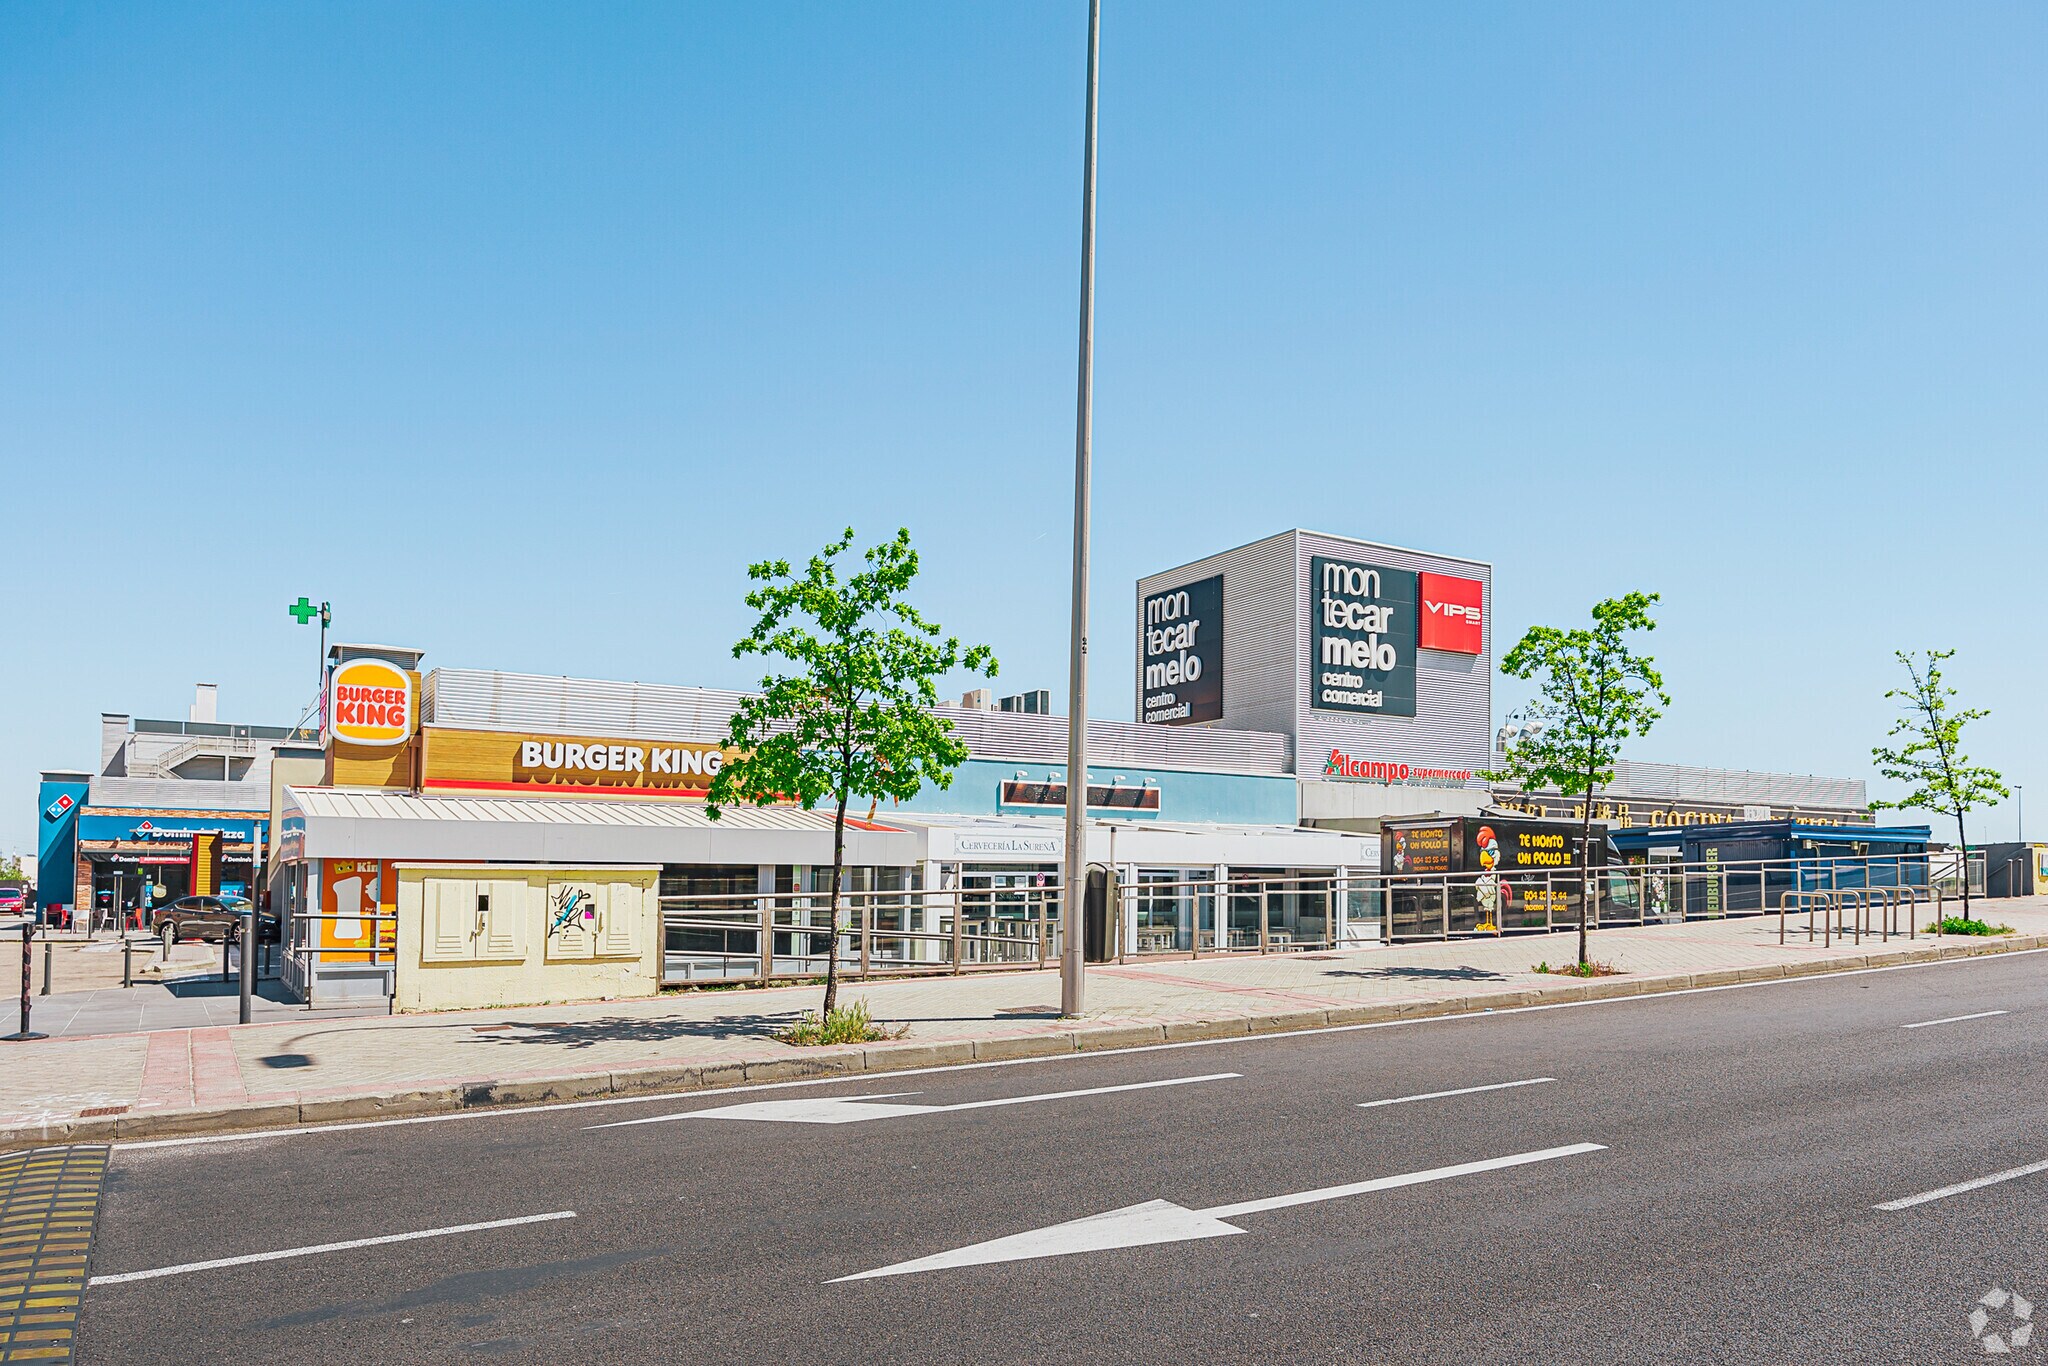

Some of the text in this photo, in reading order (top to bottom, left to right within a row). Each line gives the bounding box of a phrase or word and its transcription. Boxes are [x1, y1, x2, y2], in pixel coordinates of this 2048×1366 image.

[1323, 563, 1380, 599] mon
[1148, 590, 1190, 625] mon
[1321, 591, 1393, 634] tecar
[1424, 600, 1481, 620] VIPS
[1146, 619, 1200, 656] tecar
[1322, 633, 1397, 671] melo
[1146, 649, 1202, 690] melo
[1322, 671, 1364, 688] centro
[337, 685, 406, 705] BURGER
[1145, 691, 1177, 709] centro
[1322, 688, 1383, 708] comercial
[336, 702, 405, 727] KING
[1145, 701, 1191, 723] comercial
[522, 741, 724, 776] BURGER KING
[1325, 748, 1471, 783] Alcampo supermercado
[962, 840, 1056, 852] CERVECERÍA LA SUREÑA
[1421, 840, 1441, 850] POLLO
[1519, 833, 1564, 848] TE MONTO
[1517, 851, 1531, 865] UN
[1533, 851, 1562, 865] POLLO
[1524, 890, 1538, 901] 604
[1558, 891, 1567, 901] 44
